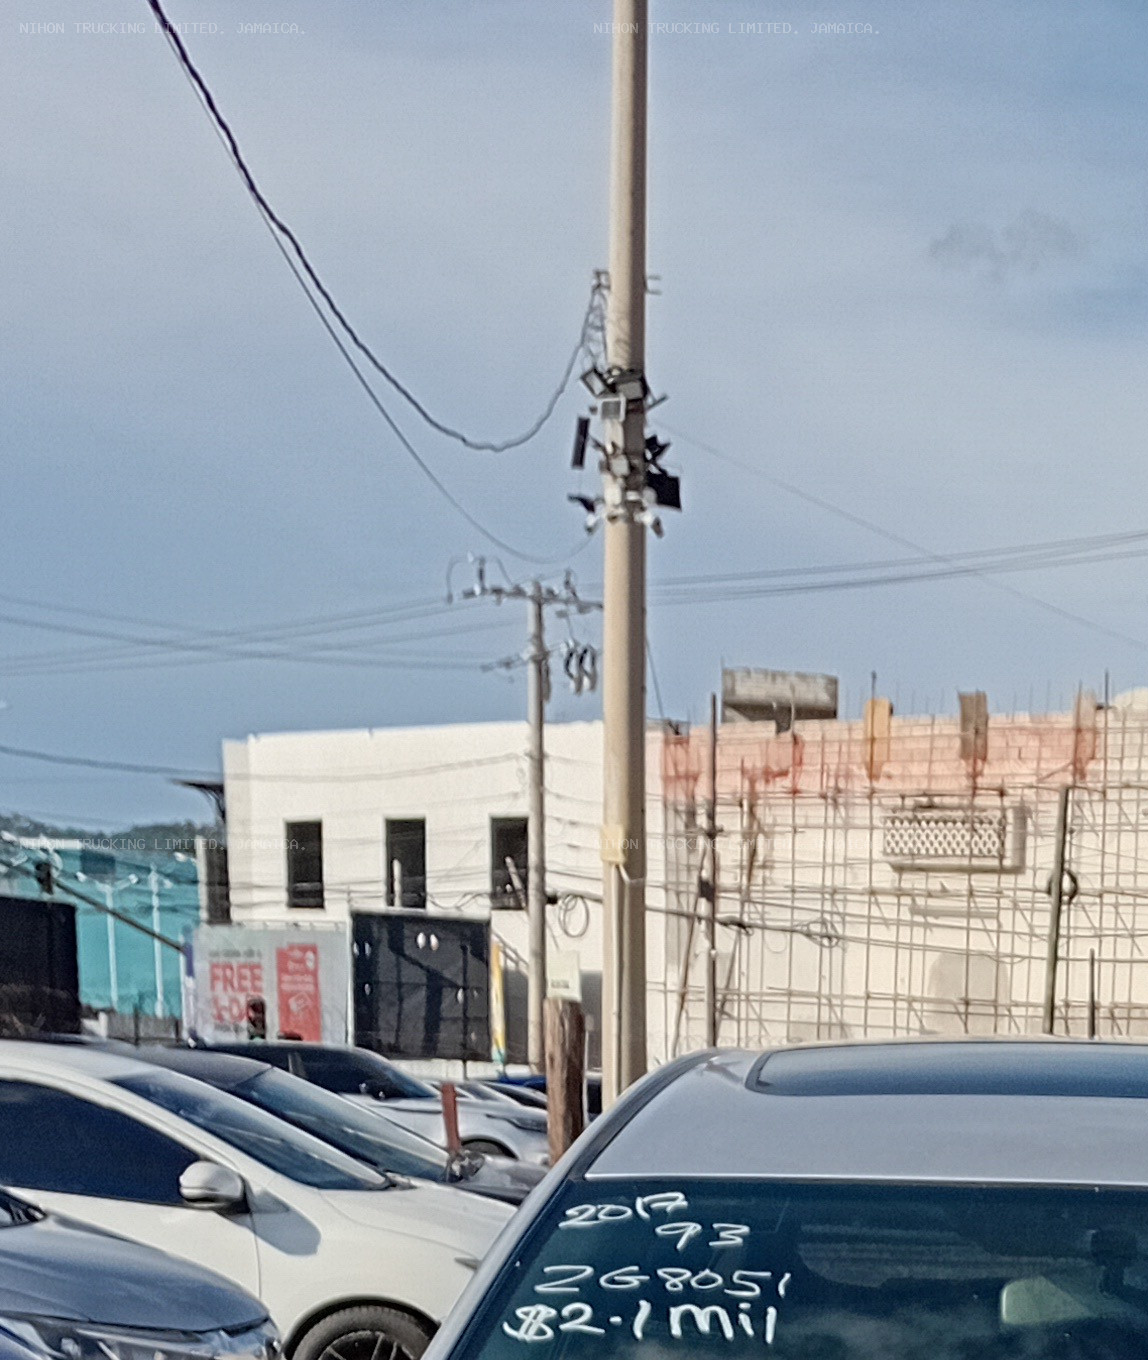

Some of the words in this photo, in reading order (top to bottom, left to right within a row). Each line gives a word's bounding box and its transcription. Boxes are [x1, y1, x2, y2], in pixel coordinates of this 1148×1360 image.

[210, 962, 263, 993] FREE
[558, 1191, 689, 1230] 2017
[655, 1221, 751, 1252] 93
